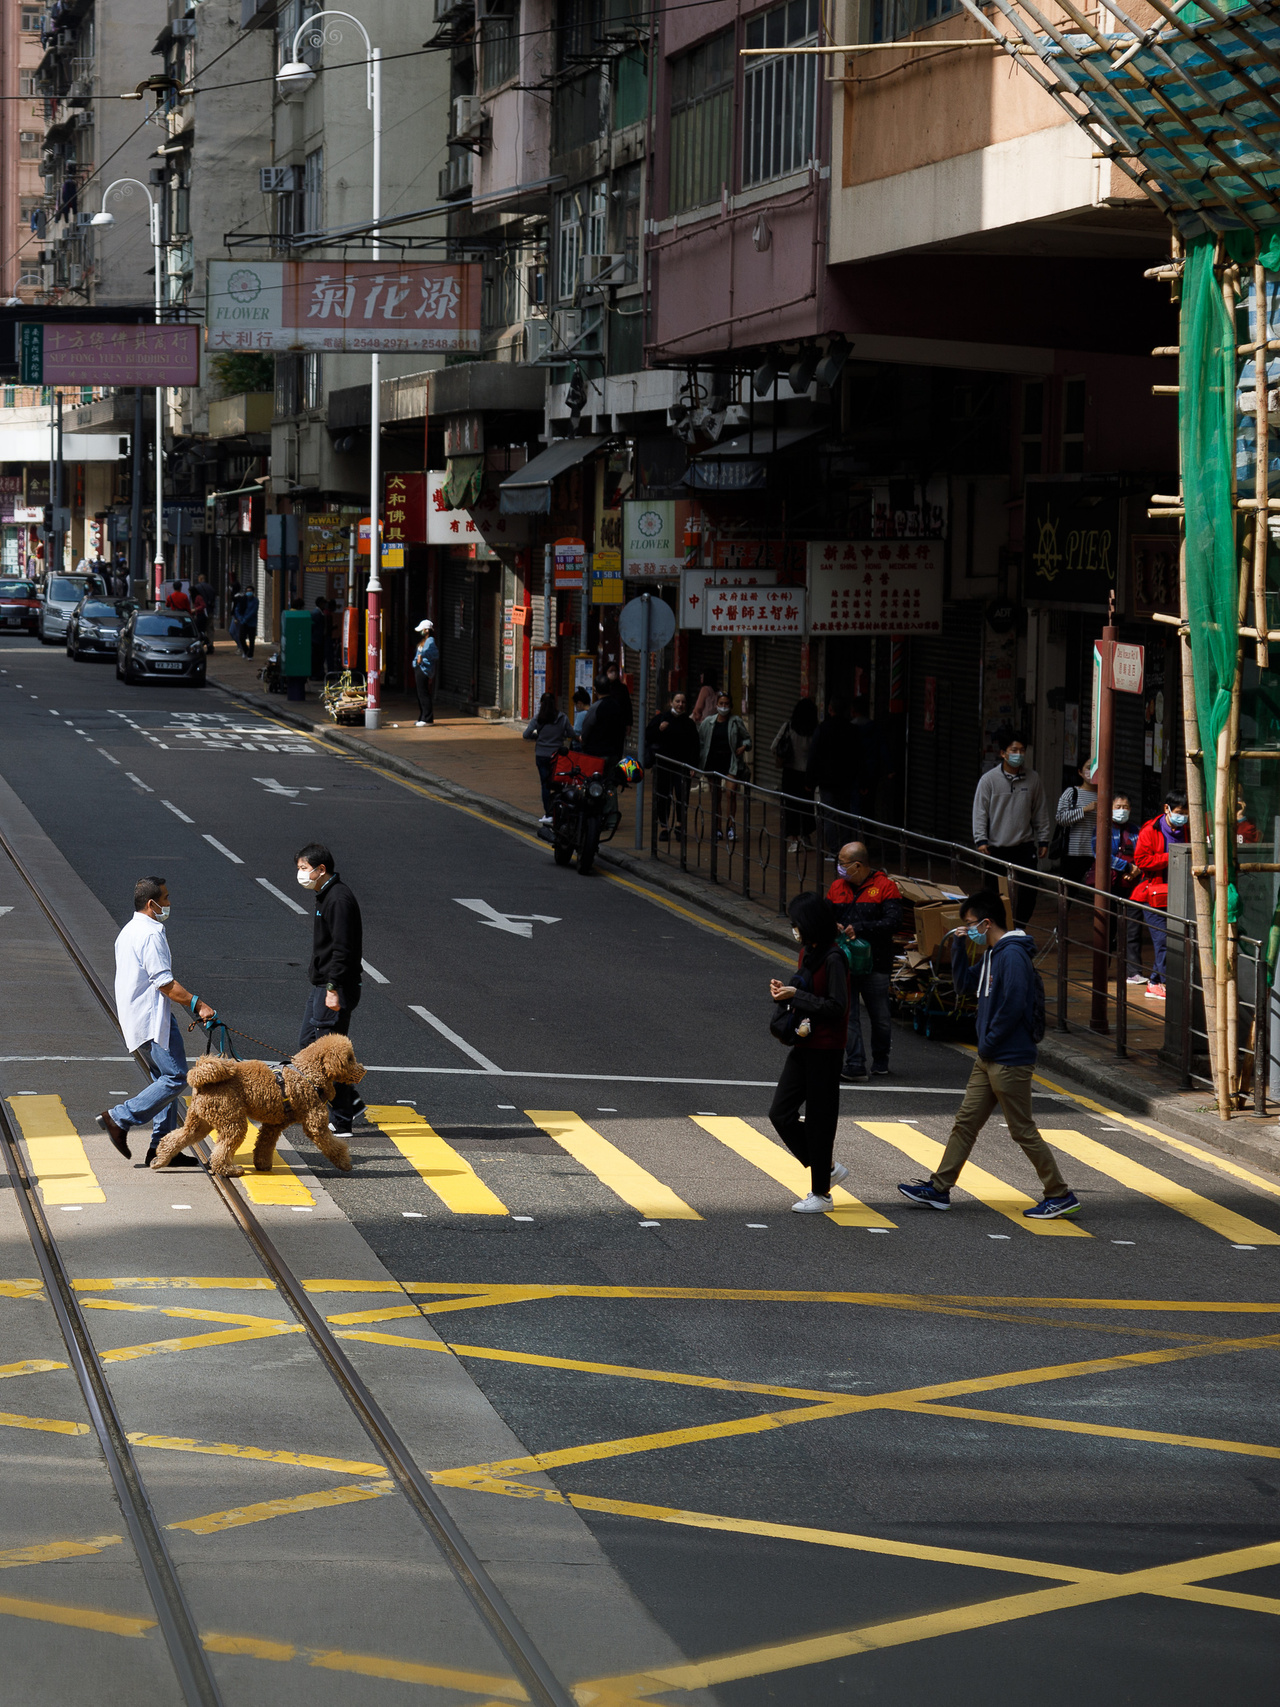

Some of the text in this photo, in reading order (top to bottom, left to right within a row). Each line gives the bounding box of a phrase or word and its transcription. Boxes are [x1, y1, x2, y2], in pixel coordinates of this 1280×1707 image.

[306, 274, 464, 320] 菊花漆
[215, 306, 270, 320] FLOWER
[215, 331, 274, 348] 大利行
[353, 338, 380, 348] 2548
[383, 338, 410, 348] 2971
[49, 353, 67, 363] SUP
[70, 353, 95, 363] FONG
[99, 353, 122, 363] YUEN
[125, 354, 170, 364] BUDDHIST
[385, 475, 407, 541] 太和佛具
[450, 519, 507, 533] 有限公司
[630, 539, 670, 550] FLOWER
[1065, 529, 1116, 580] PIER
[712, 605, 799, 621] 中醫師王智新
[993, 607, 1013, 618] ADT
